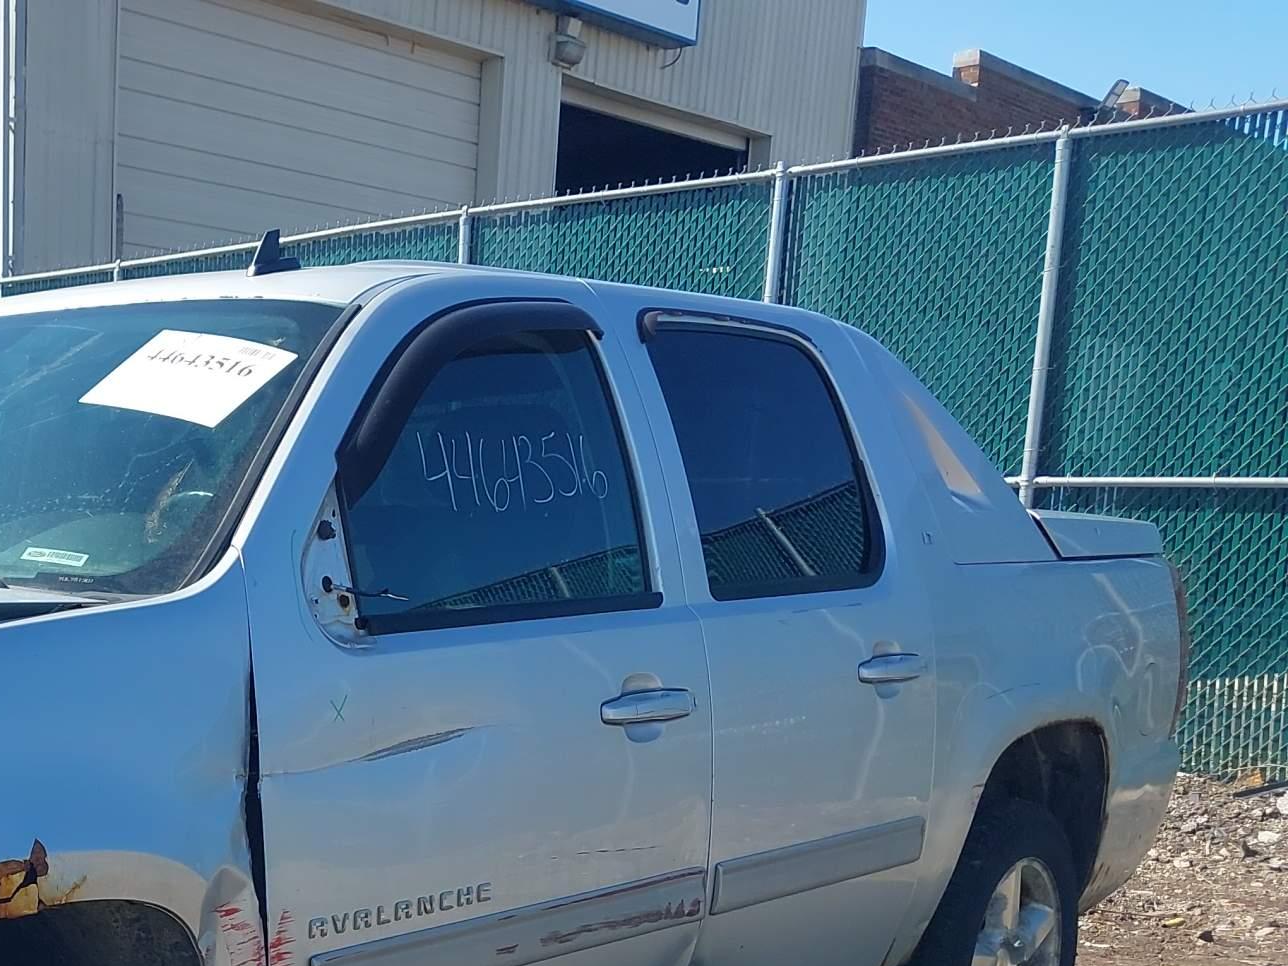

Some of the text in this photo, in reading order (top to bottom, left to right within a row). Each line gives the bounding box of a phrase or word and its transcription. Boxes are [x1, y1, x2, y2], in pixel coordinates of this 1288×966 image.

[147, 349, 256, 377] 44643516
[416, 431, 608, 513] 44643516
[308, 882, 493, 939] AVALANCHE
